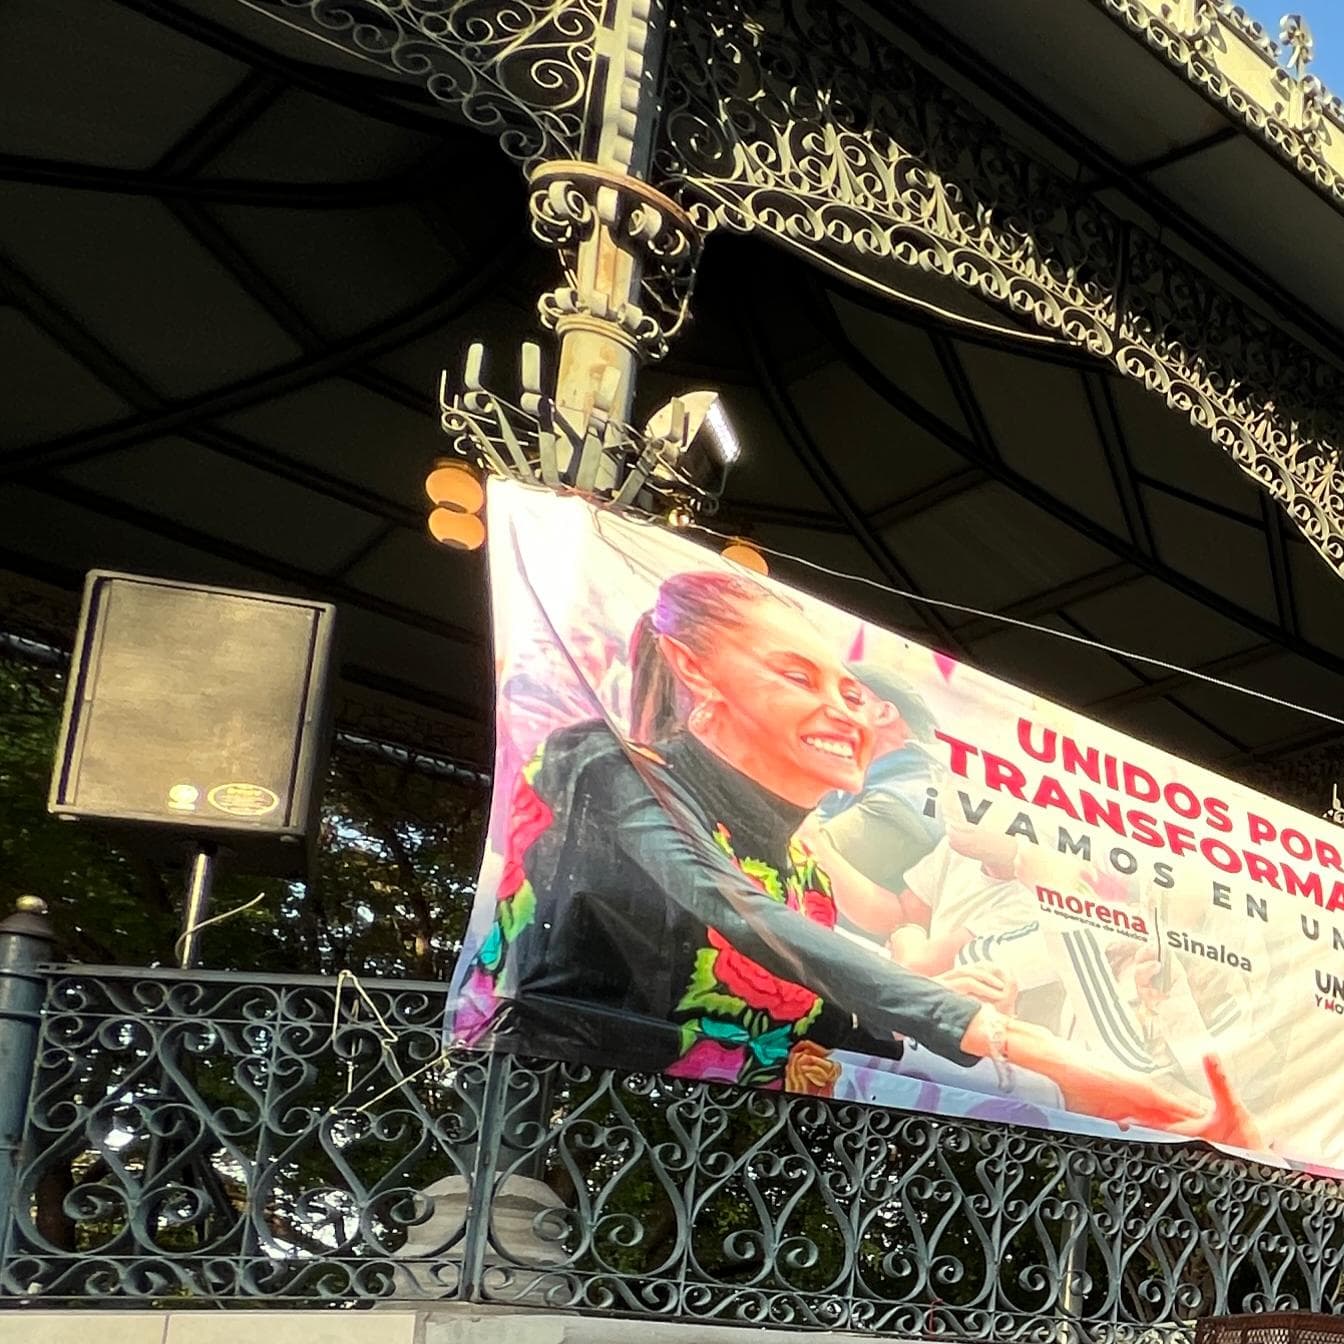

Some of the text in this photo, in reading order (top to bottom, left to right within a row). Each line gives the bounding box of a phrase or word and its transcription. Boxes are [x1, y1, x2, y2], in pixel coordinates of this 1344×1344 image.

[1016, 718, 1233, 833] UNIDOS
[1036, 885, 1149, 934] morena
[1212, 881, 1268, 922] EN
[1166, 930, 1252, 972] Sinaloa
[1315, 994, 1323, 1008] Y
